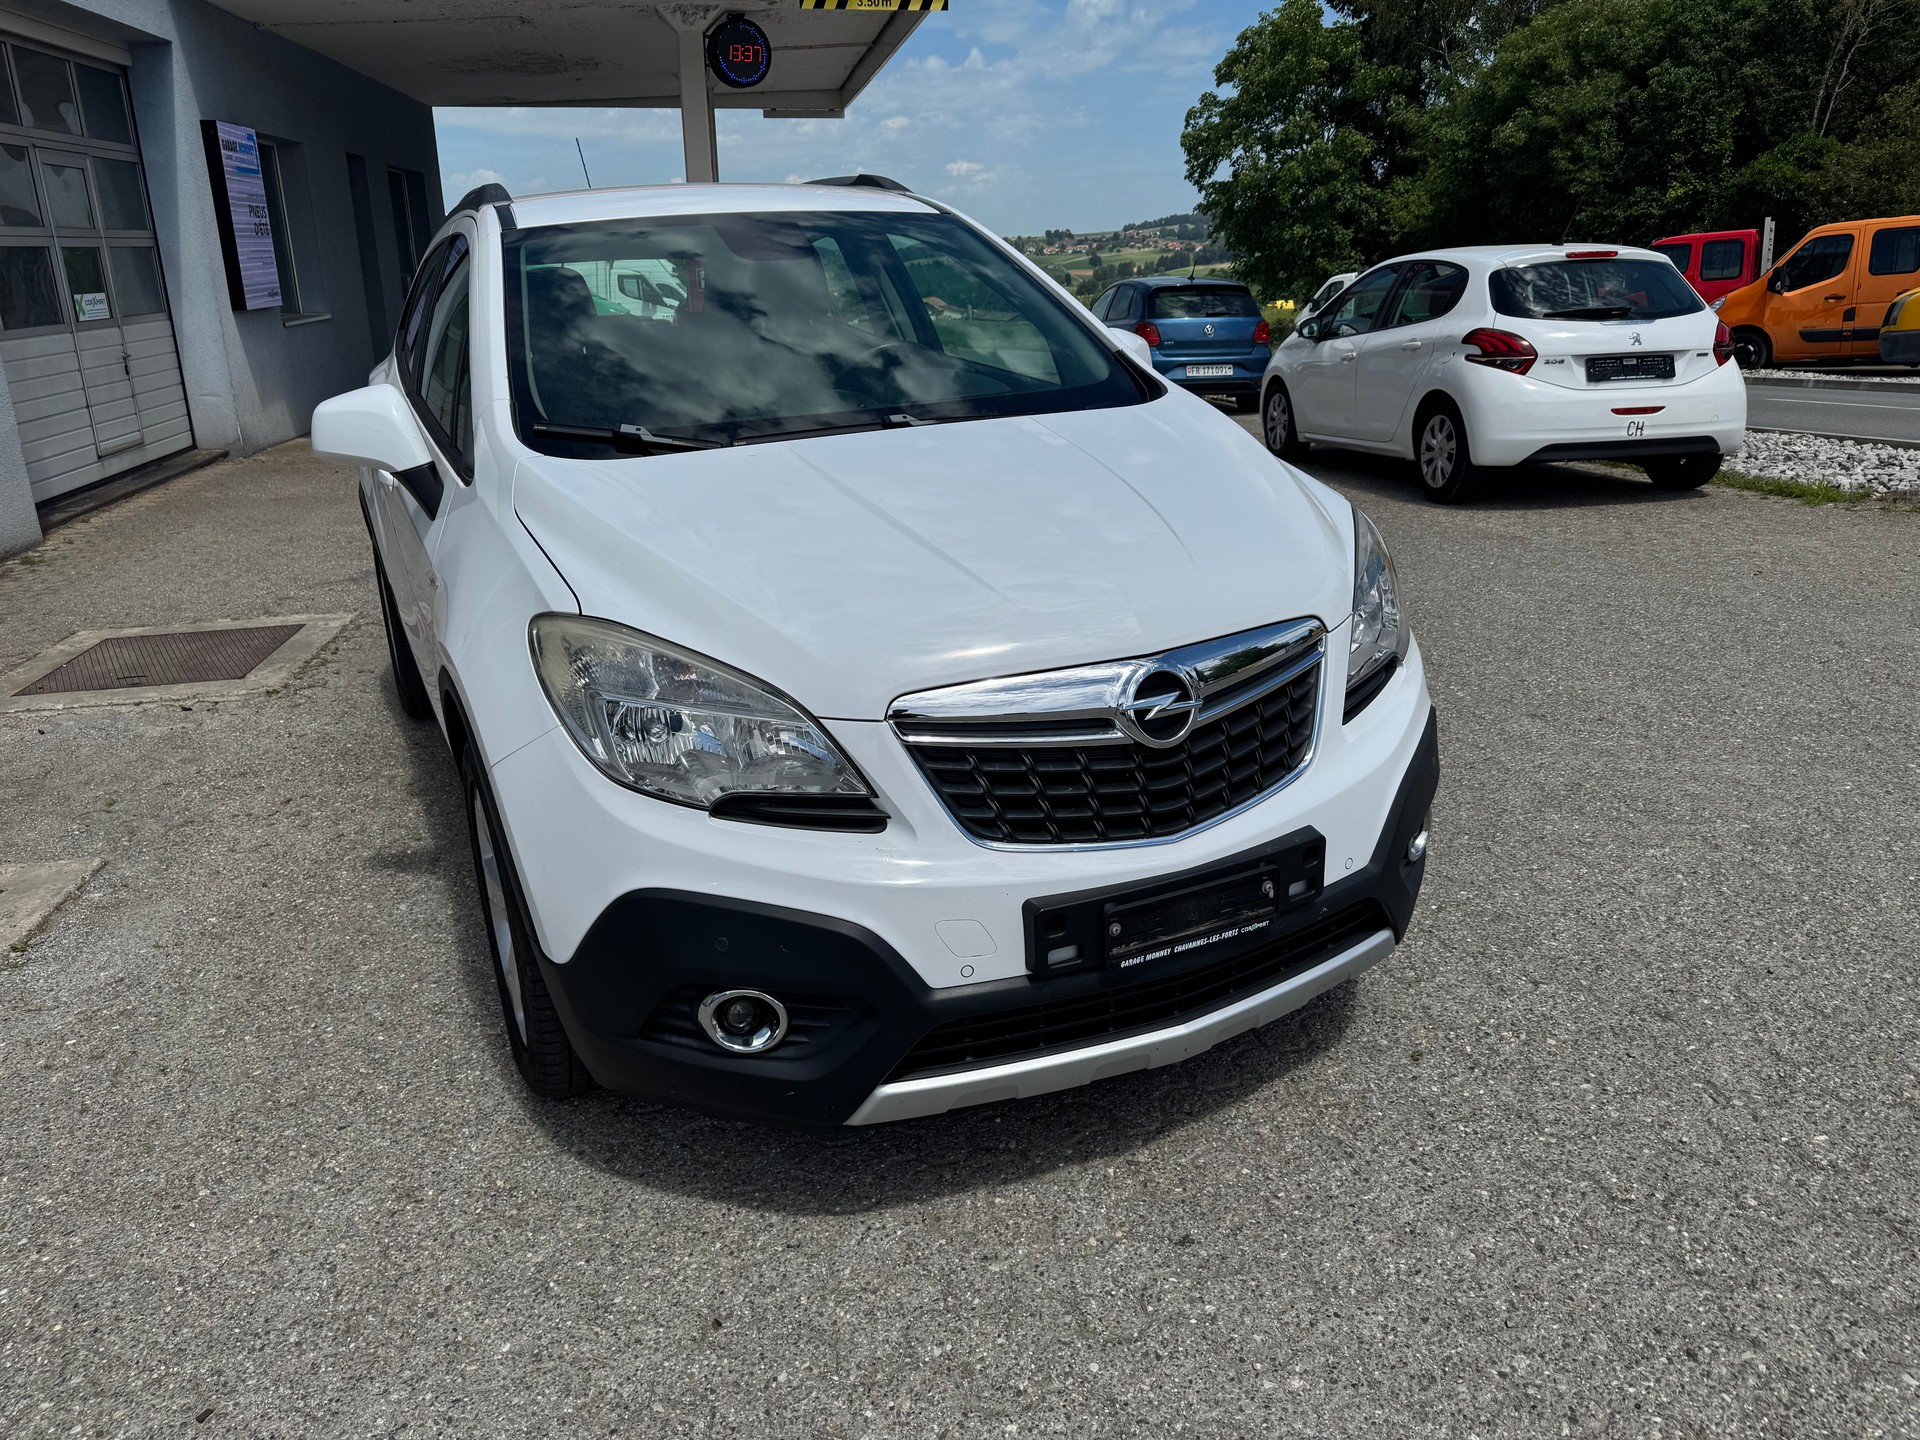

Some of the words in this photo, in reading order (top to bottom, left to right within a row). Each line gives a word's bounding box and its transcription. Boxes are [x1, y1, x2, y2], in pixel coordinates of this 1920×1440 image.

[730, 45, 761, 61] 13:37
[221, 139, 238, 152] GARAGE
[249, 204, 267, 219] PNEUS
[1627, 421, 1644, 436] CH
[1120, 956, 1145, 968] GARAGE
[1145, 948, 1172, 962] MONNEY
[1175, 929, 1239, 953] CHAVANNES-LES-FORTS
